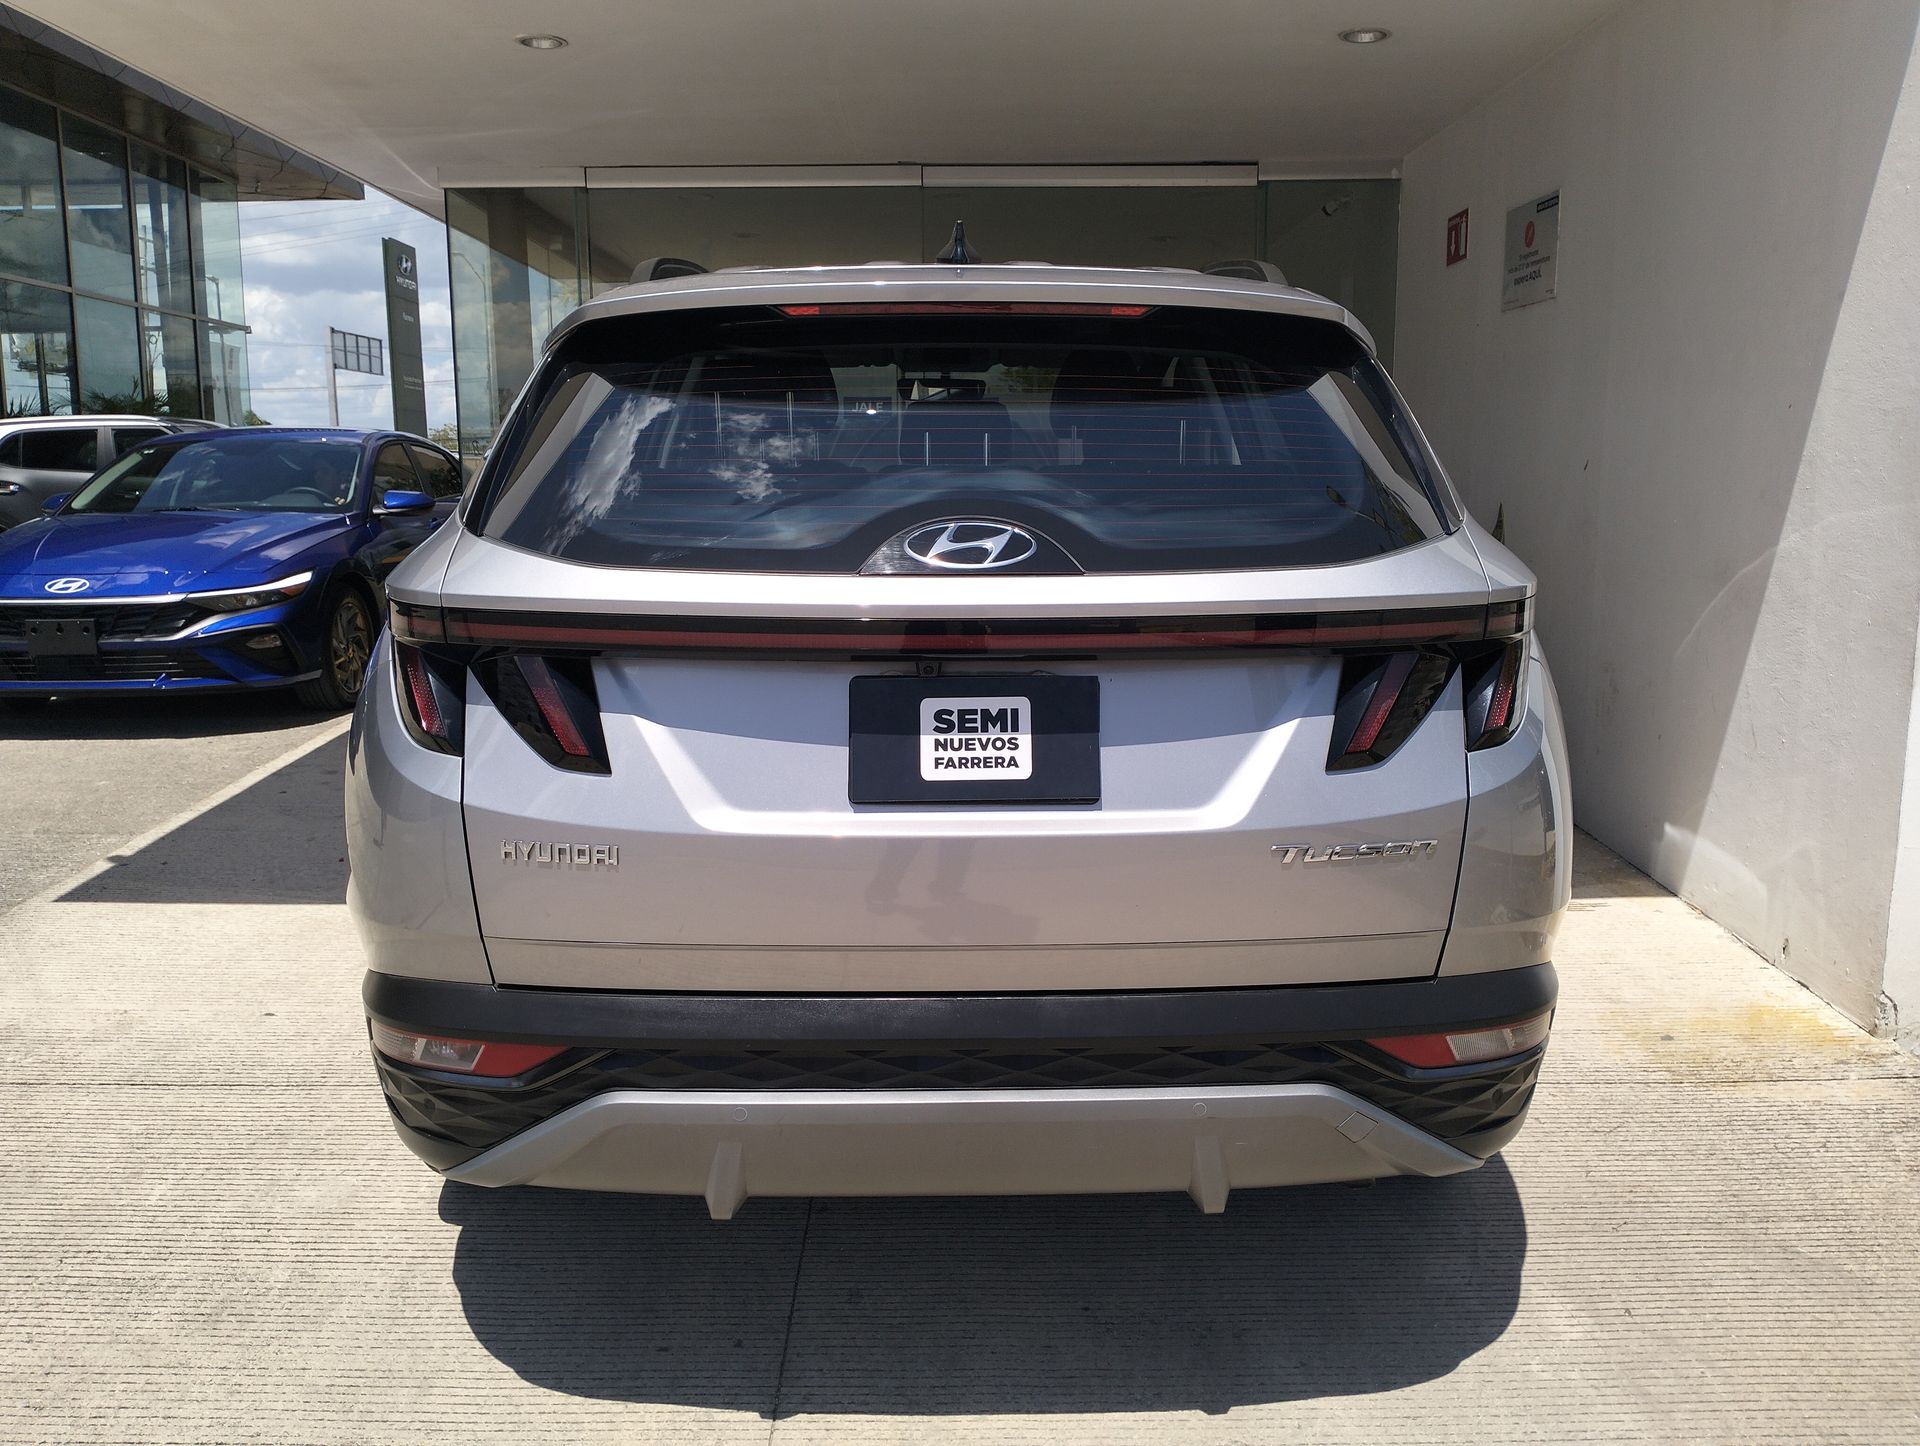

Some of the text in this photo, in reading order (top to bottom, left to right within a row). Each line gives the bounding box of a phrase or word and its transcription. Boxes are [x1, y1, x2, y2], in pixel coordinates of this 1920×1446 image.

[932, 708, 1020, 735] SEMI
[934, 737, 1020, 752] NUEVOS
[934, 756, 1020, 770] FARRERA
[500, 840, 619, 866] HYUNDAI
